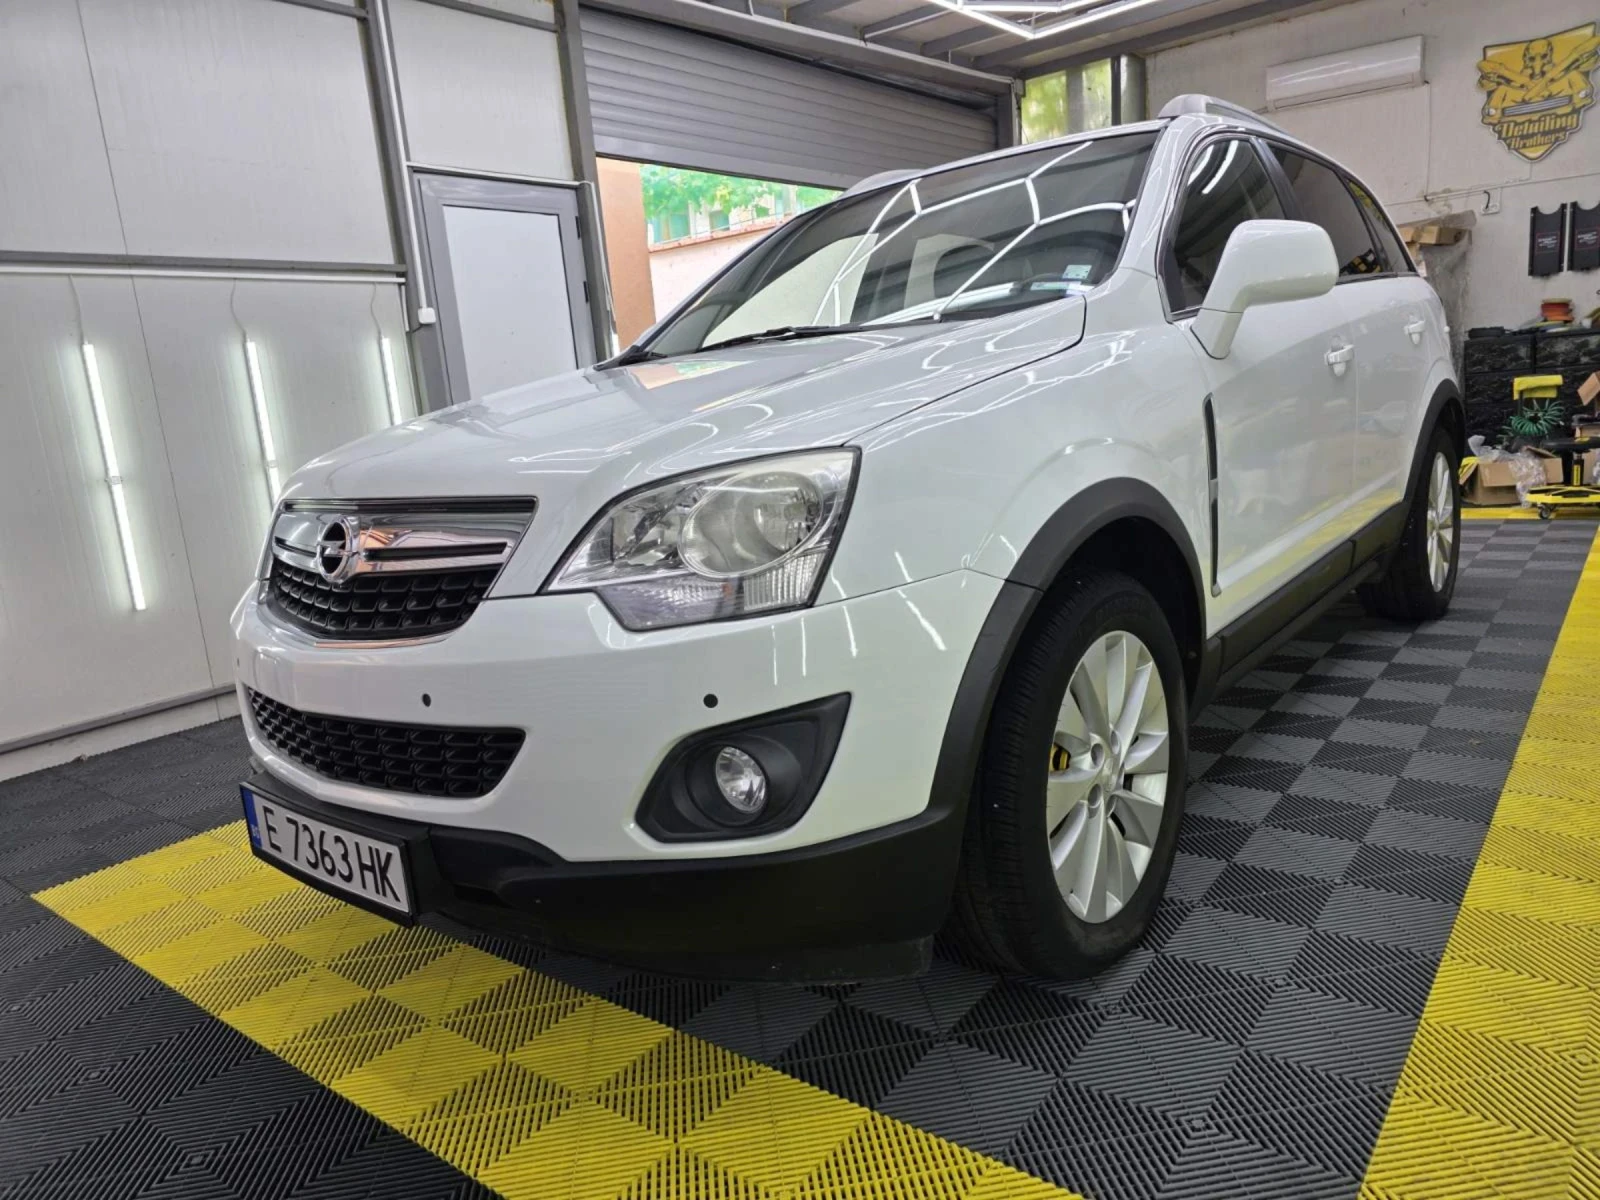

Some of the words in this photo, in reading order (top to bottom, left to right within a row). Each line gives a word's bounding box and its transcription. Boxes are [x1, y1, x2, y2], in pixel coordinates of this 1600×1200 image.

[263, 806, 282, 853] E
[286, 816, 354, 883] 7363
[355, 841, 401, 902] HK
